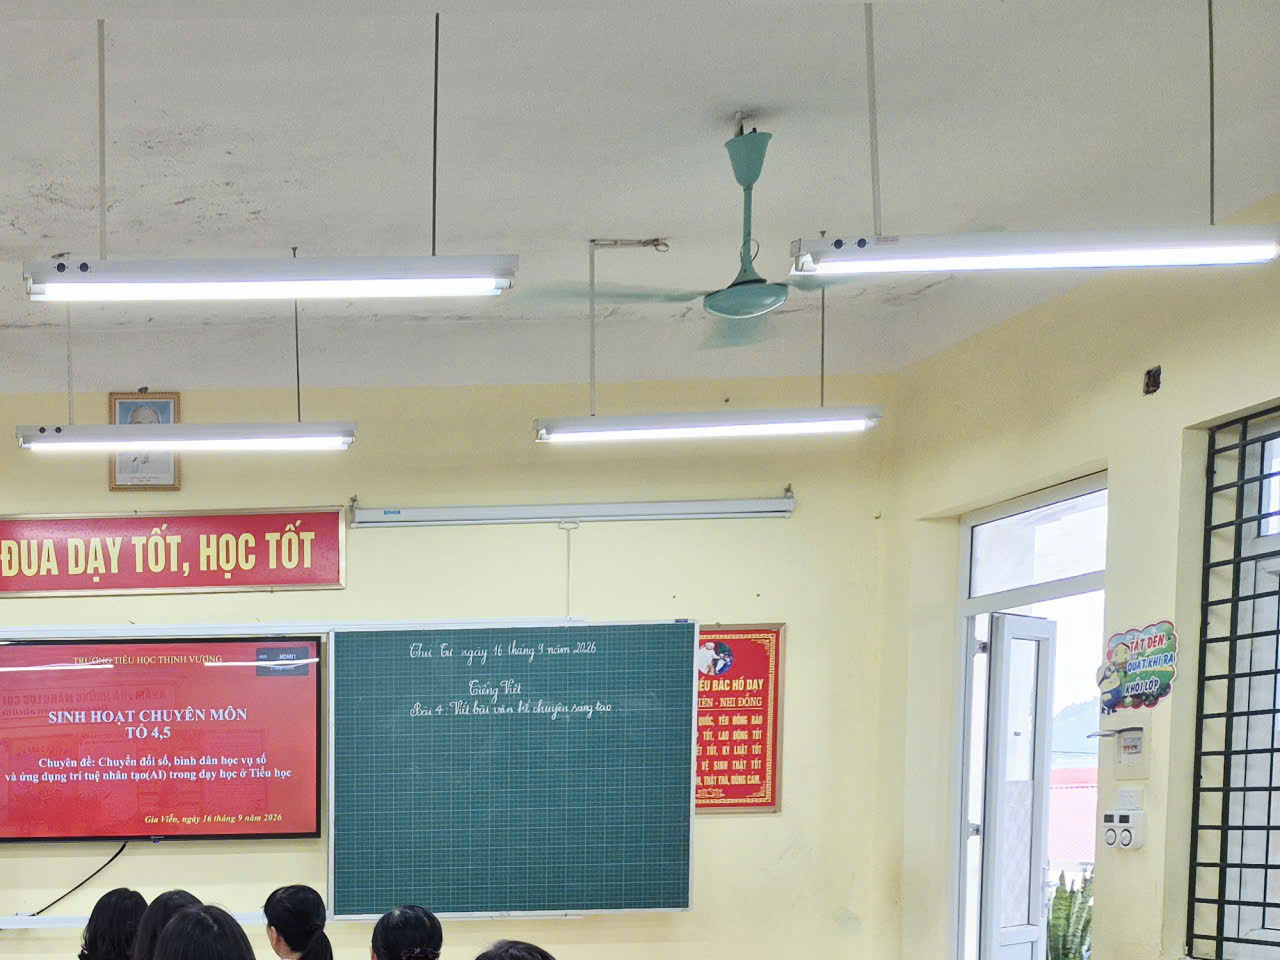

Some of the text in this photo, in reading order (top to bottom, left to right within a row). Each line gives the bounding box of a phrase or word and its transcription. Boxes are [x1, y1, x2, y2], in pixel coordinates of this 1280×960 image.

[0, 538, 59, 577] ĐUA
[68, 536, 122, 582] DẠY
[131, 524, 190, 576] TỐT,
[199, 533, 256, 579] HỌC
[265, 520, 315, 569] TỐT
[1147, 632, 1166, 648] ĐÈN,
[137, 656, 157, 665] HỌC
[158, 655, 187, 665] THỊNH
[410, 640, 598, 666] Thứ Tư ngày 16 tháng 9 năm 2026
[1127, 652, 1174, 674] QUẠT KHI RA
[469, 680, 522, 704] Tiếng Việt
[712, 677, 730, 691] BÁC
[746, 679, 764, 693] DẠY
[1125, 677, 1159, 694] KHỎI LỚP
[698, 695, 713, 708] IÊN
[720, 697, 737, 708] NHI
[738, 692, 763, 707] ĐỒNG
[48, 710, 86, 723] SINH
[91, 710, 136, 725] HOẠT
[139, 705, 205, 722] CHUYÊN
[210, 705, 247, 721] MÔN
[450, 699, 471, 716] Viết
[472, 701, 490, 715] bài
[493, 703, 515, 715] văn
[532, 700, 570, 720] chuyện
[570, 703, 594, 719] sáng
[594, 700, 612, 715] tạo
[151, 727, 171, 740] 4,5
[38, 752, 267, 770] Chuyên đề: Chuyển đổi số, bình dân học vụ số
[5, 766, 292, 784] và ứng dụng trí tuệ nhân tạo(AI) trong dạy học ở Tiểu học
[144, 815, 159, 824] Gia
[182, 815, 201, 825] ngày
[203, 815, 213, 823] 16
[214, 814, 237, 824] tháng
[238, 814, 243, 822] 9
[245, 814, 262, 823] năm
[264, 813, 283, 823] 2026
